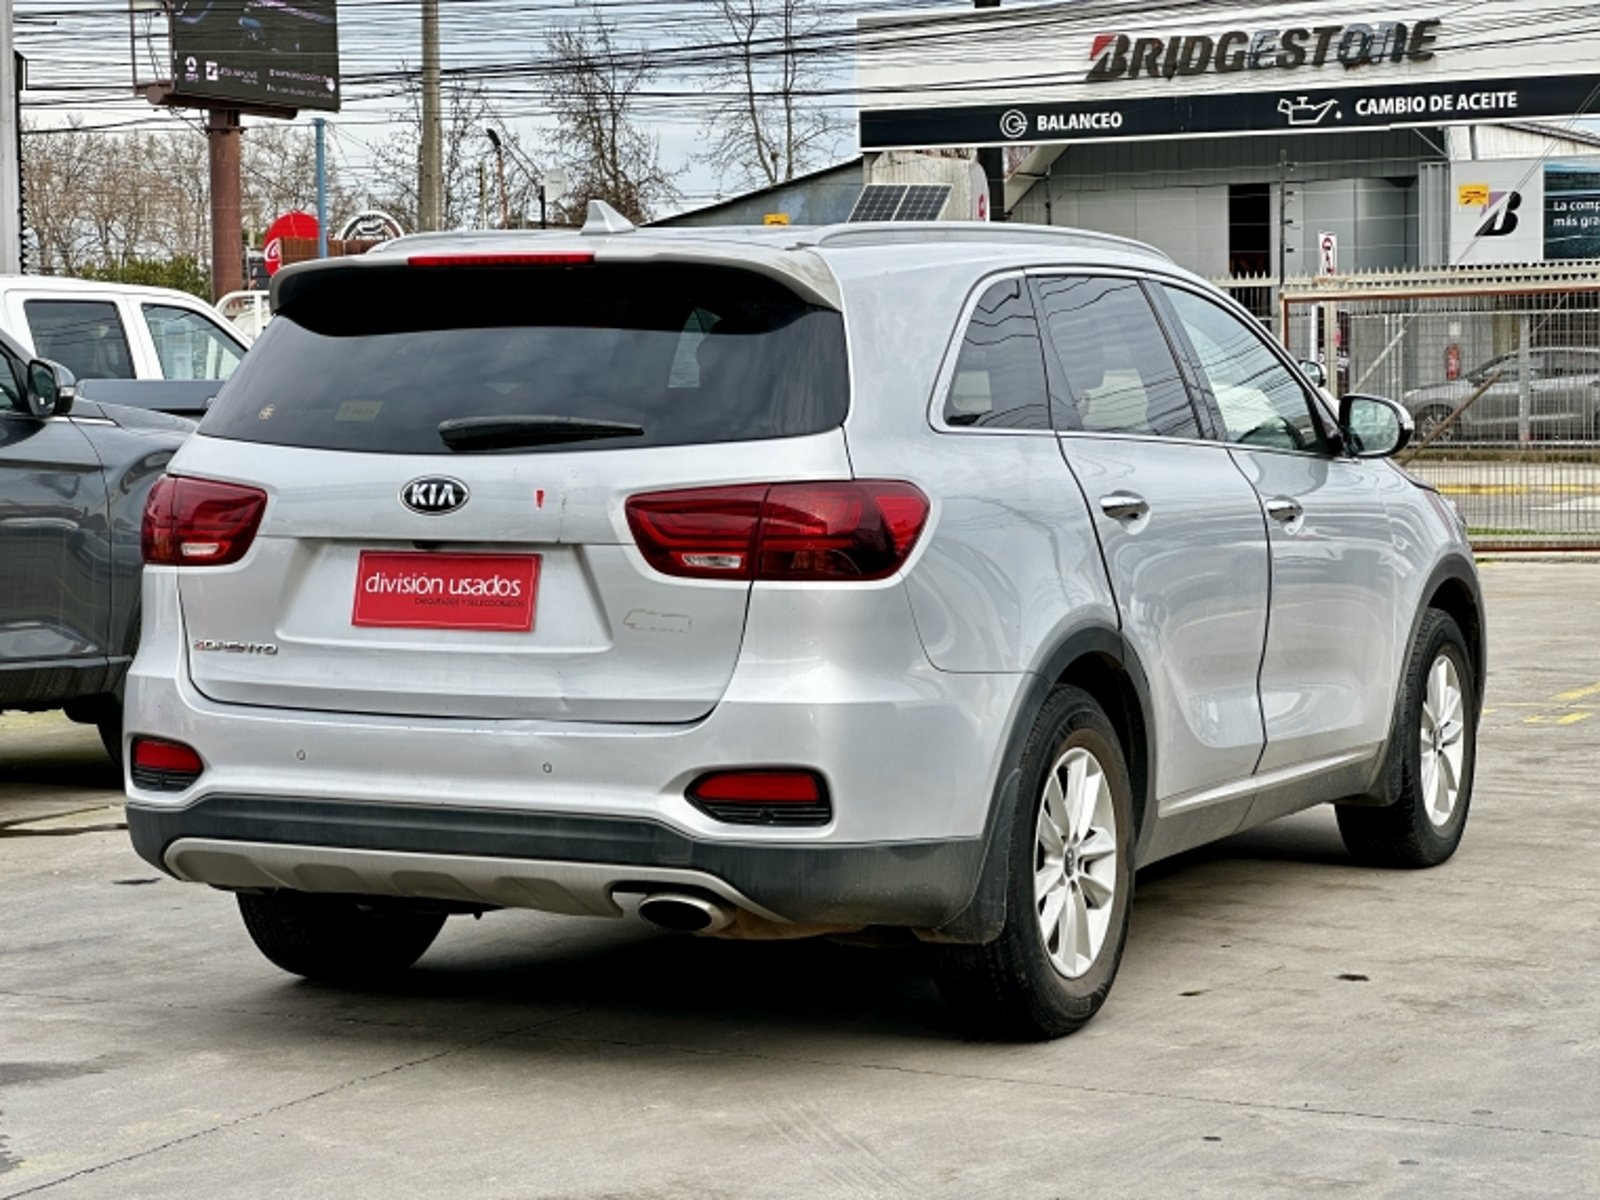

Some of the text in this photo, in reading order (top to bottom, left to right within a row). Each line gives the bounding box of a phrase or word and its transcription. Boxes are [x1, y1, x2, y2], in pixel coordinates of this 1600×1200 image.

[1085, 17, 1442, 82] BRIDGESTONE
[1355, 91, 1518, 115] CAMBIO DE ACEITE
[1037, 111, 1123, 131] BALANCEO
[1553, 201, 1567, 211] La
[1553, 214, 1578, 227] más
[410, 483, 456, 506] KIA
[365, 572, 521, 597] división usados
